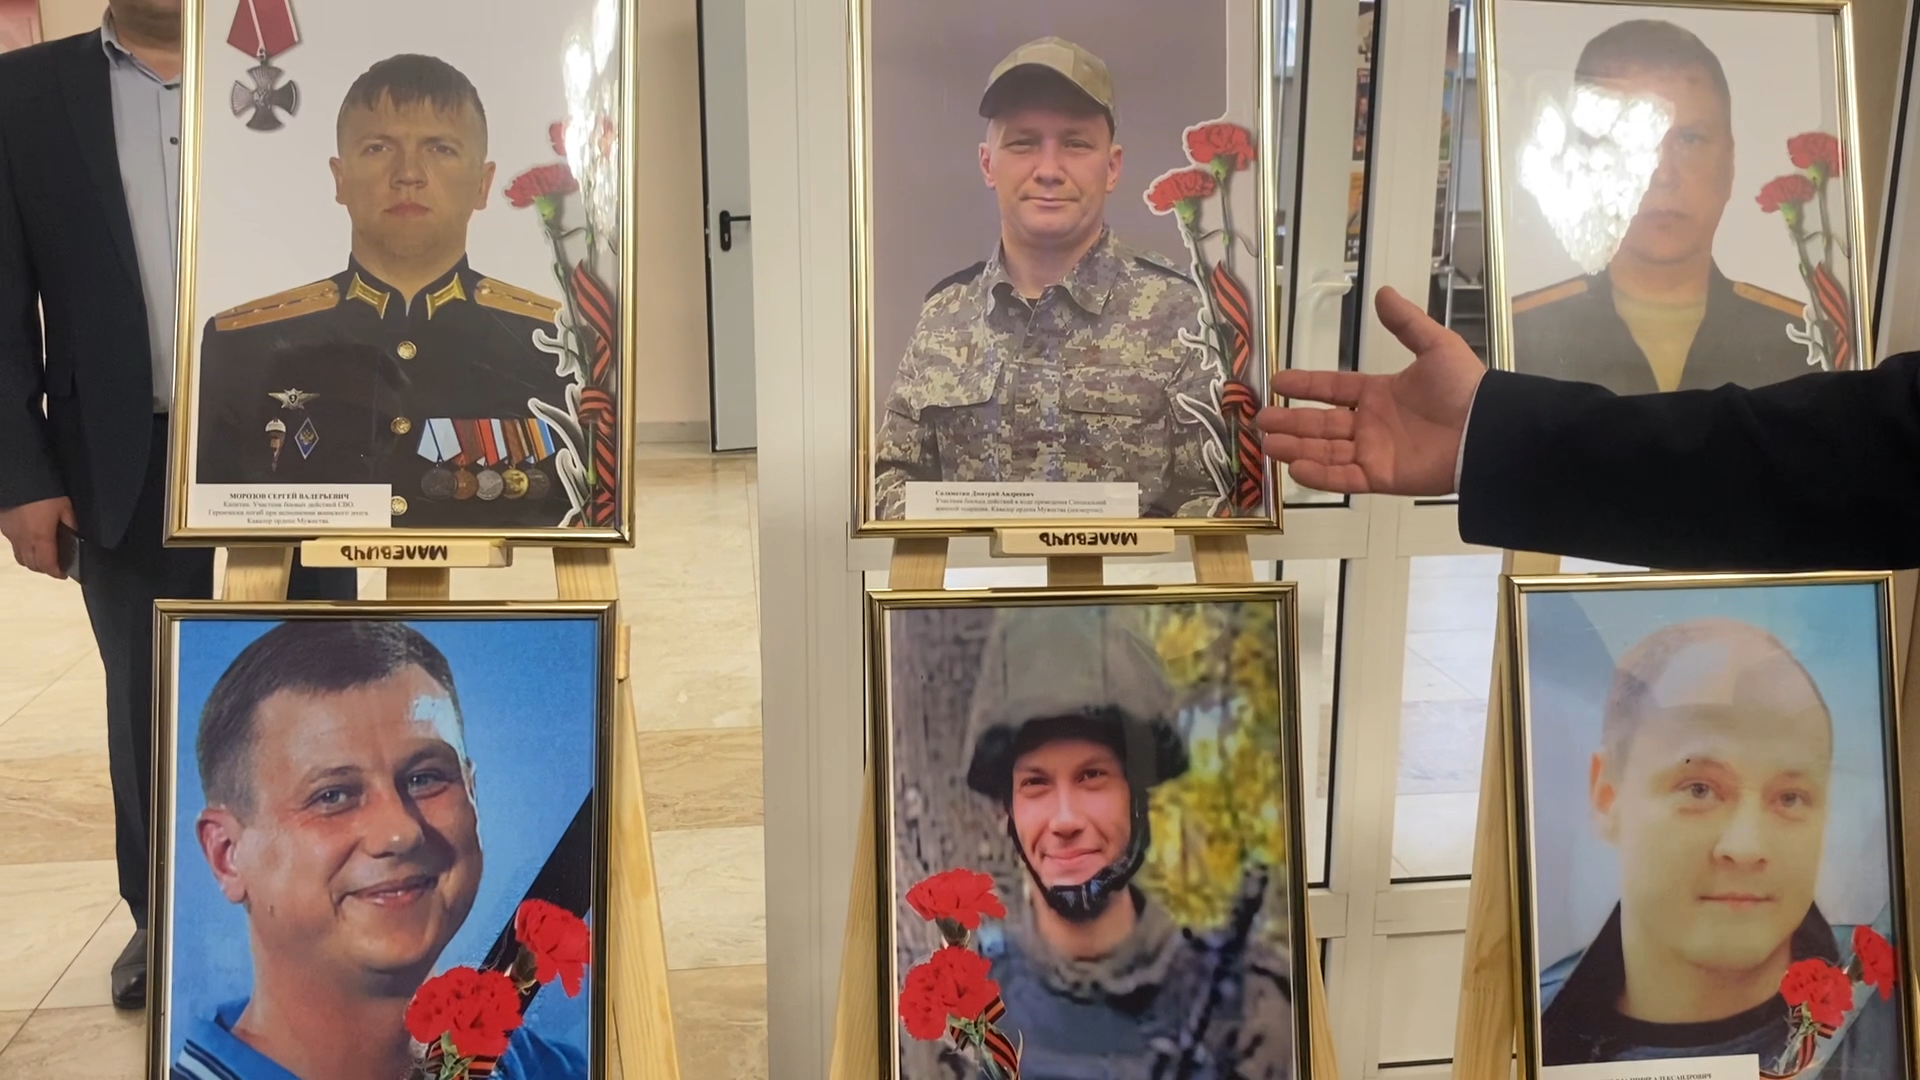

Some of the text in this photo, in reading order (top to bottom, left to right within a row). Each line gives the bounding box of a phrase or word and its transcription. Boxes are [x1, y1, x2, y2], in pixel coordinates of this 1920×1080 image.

[268, 492, 298, 500] СЕРГЕЙ
[1039, 532, 1137, 546] МАЛЕВИЧЪ
[340, 545, 447, 560] МАЛЕВИЧЪ
